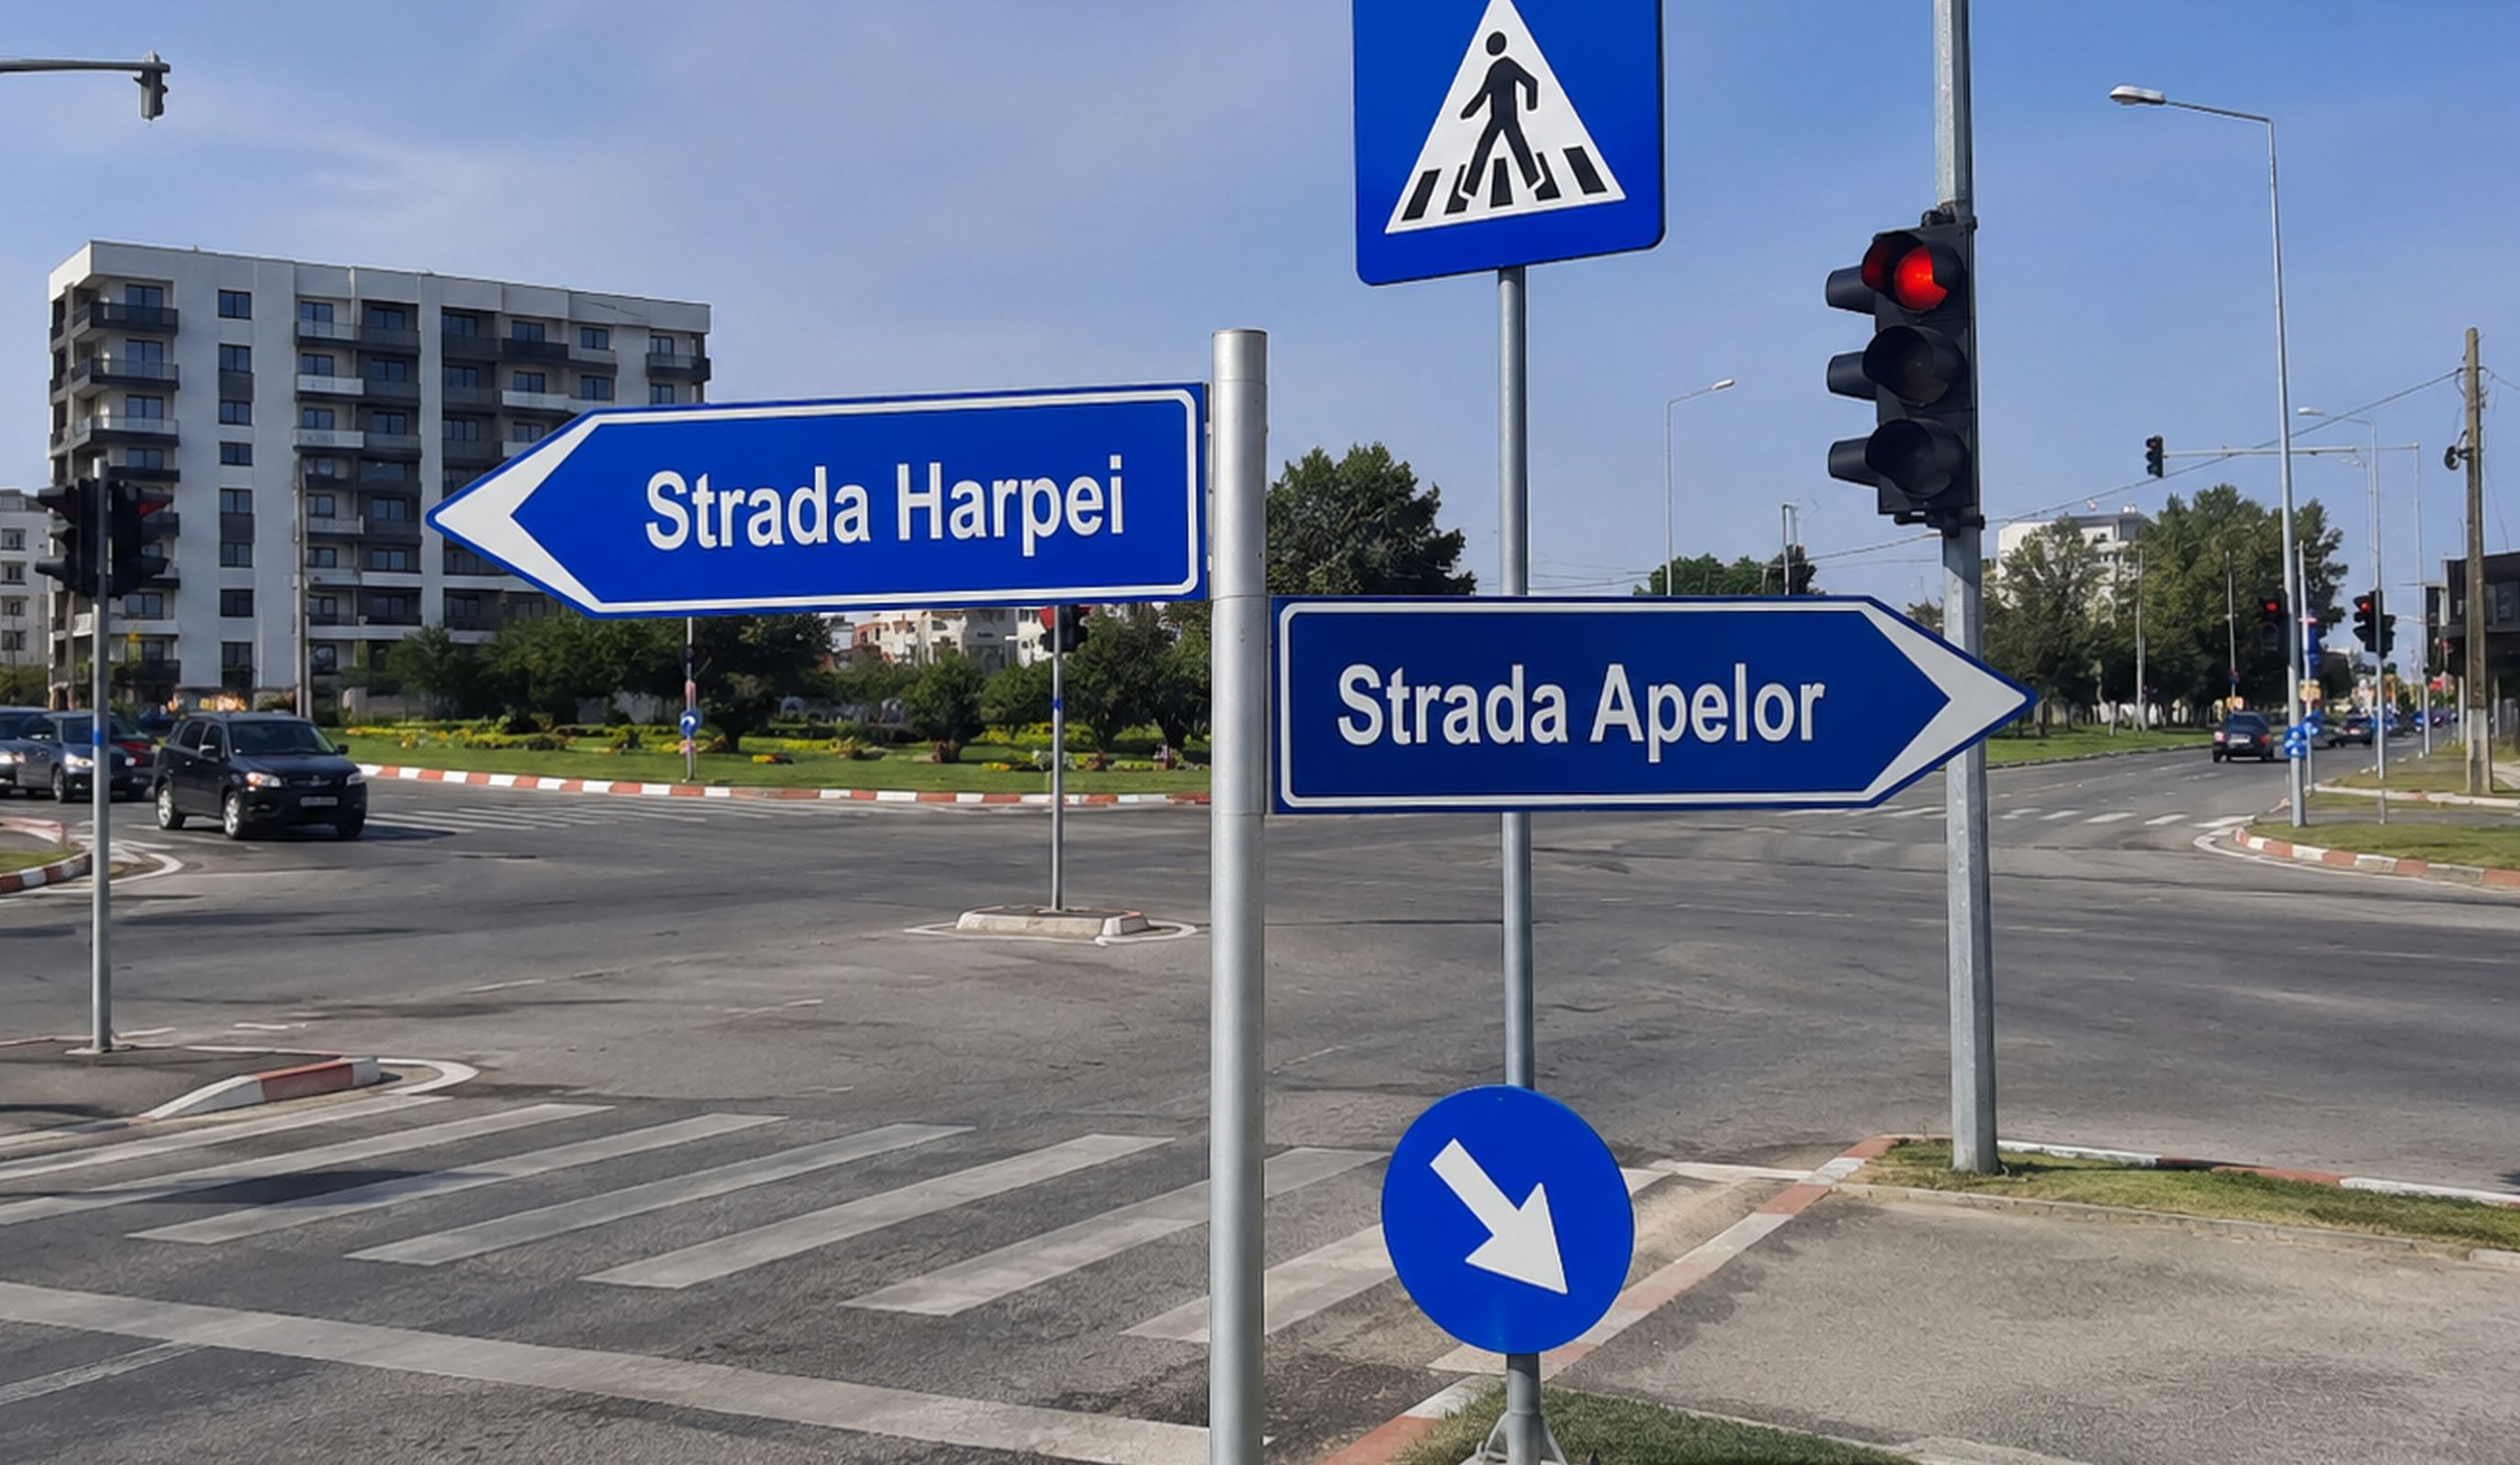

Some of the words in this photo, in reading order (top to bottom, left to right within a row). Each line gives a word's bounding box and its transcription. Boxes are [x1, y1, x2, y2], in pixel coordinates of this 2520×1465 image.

[644, 464, 871, 551] Strada
[896, 453, 1124, 559] Harpei
[1336, 663, 1569, 746] Strada
[1589, 662, 1826, 764] Apelor
